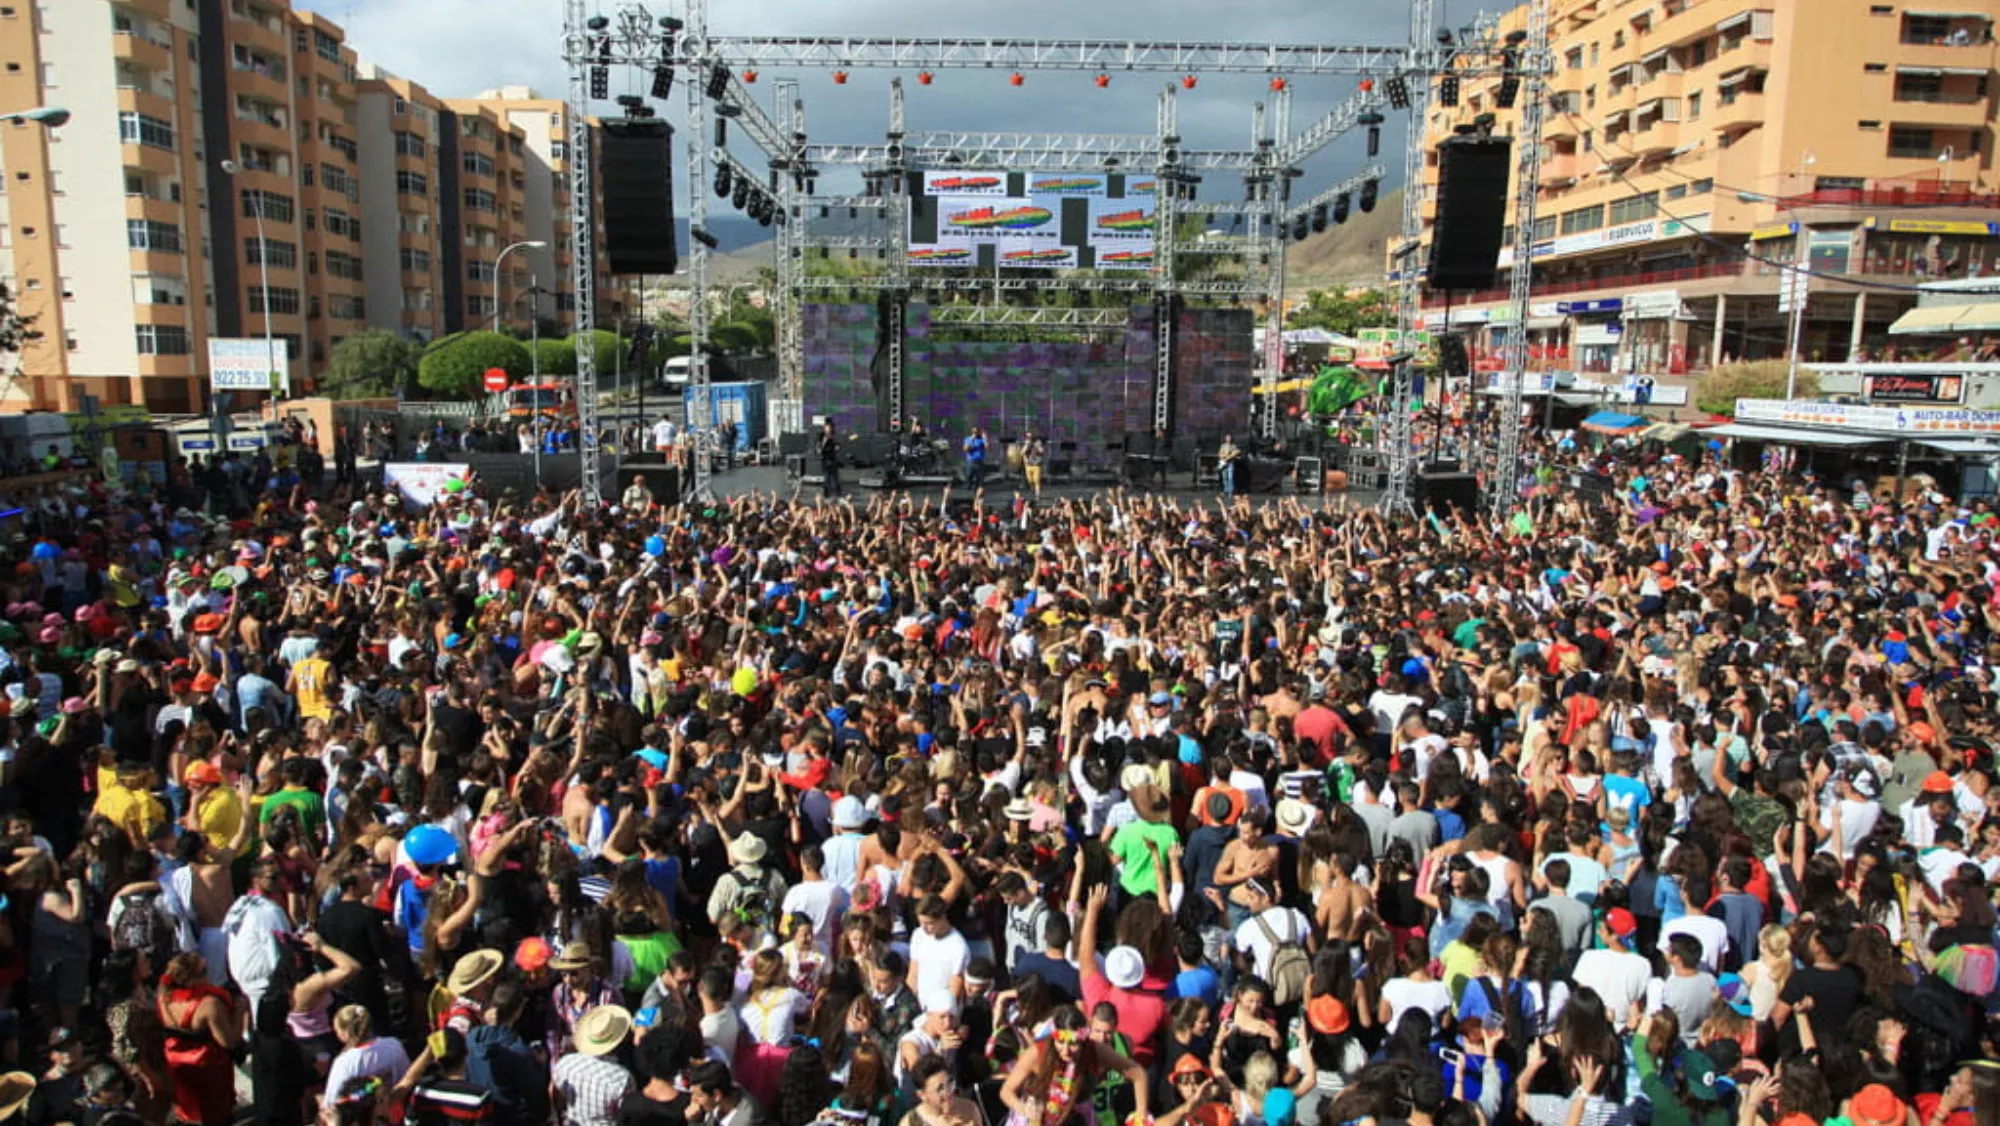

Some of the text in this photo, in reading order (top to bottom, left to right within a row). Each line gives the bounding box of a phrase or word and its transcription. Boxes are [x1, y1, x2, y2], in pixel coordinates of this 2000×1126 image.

[214, 370, 235, 385] 922
[236, 371, 251, 385] 75
[1914, 411, 1969, 420] AUTO-BAR
